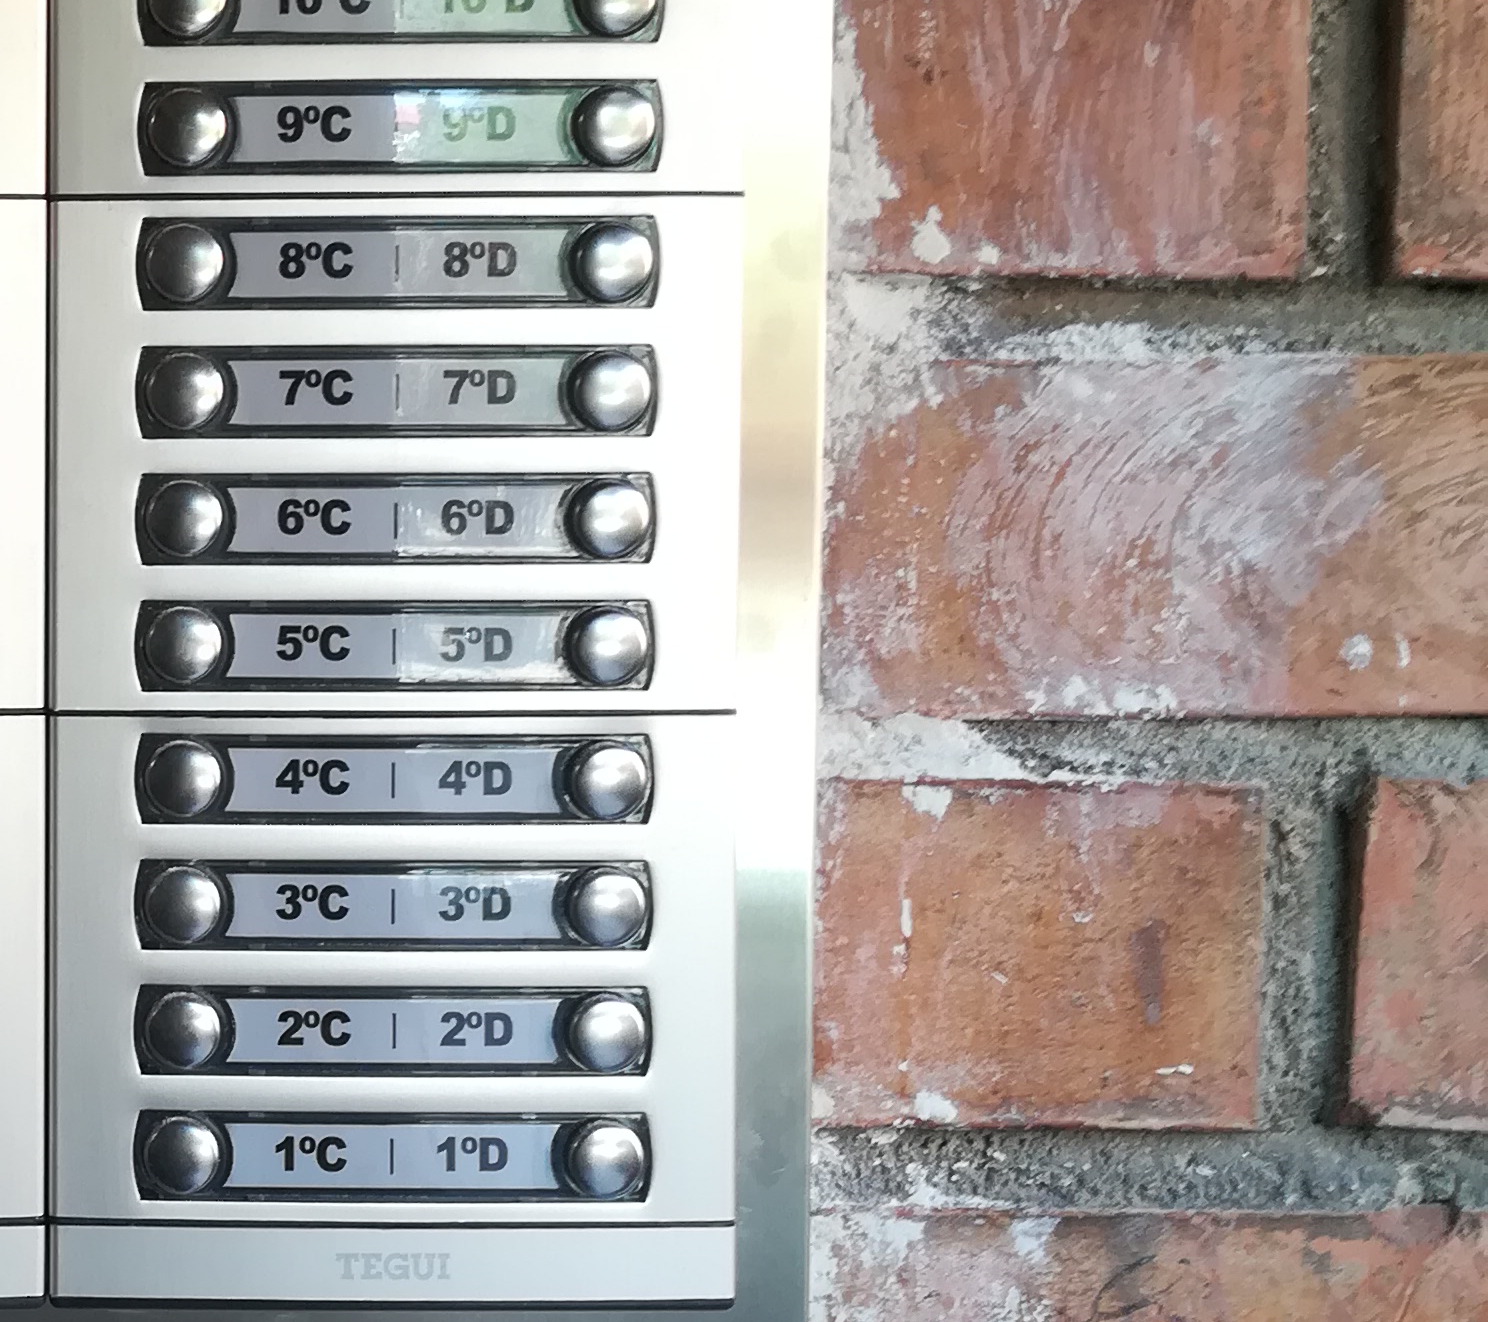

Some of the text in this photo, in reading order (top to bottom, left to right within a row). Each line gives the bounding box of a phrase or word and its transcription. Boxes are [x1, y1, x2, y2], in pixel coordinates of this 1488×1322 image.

[277, 106, 351, 142] 9ºC
[279, 242, 517, 279] 8ºC 8ºD
[279, 370, 517, 405] 7ºC 7ºD
[278, 499, 515, 535] 6ºC 6ºD
[277, 625, 513, 662] 5ºC 5ºD
[276, 759, 512, 795] 4ºC 4ºD
[276, 884, 511, 921] 3ºC 3ºD
[278, 1011, 513, 1046] 2ºC 2ºD
[276, 1136, 508, 1172] 1ºC 1ºD
[336, 1253, 451, 1281] TEGUI
